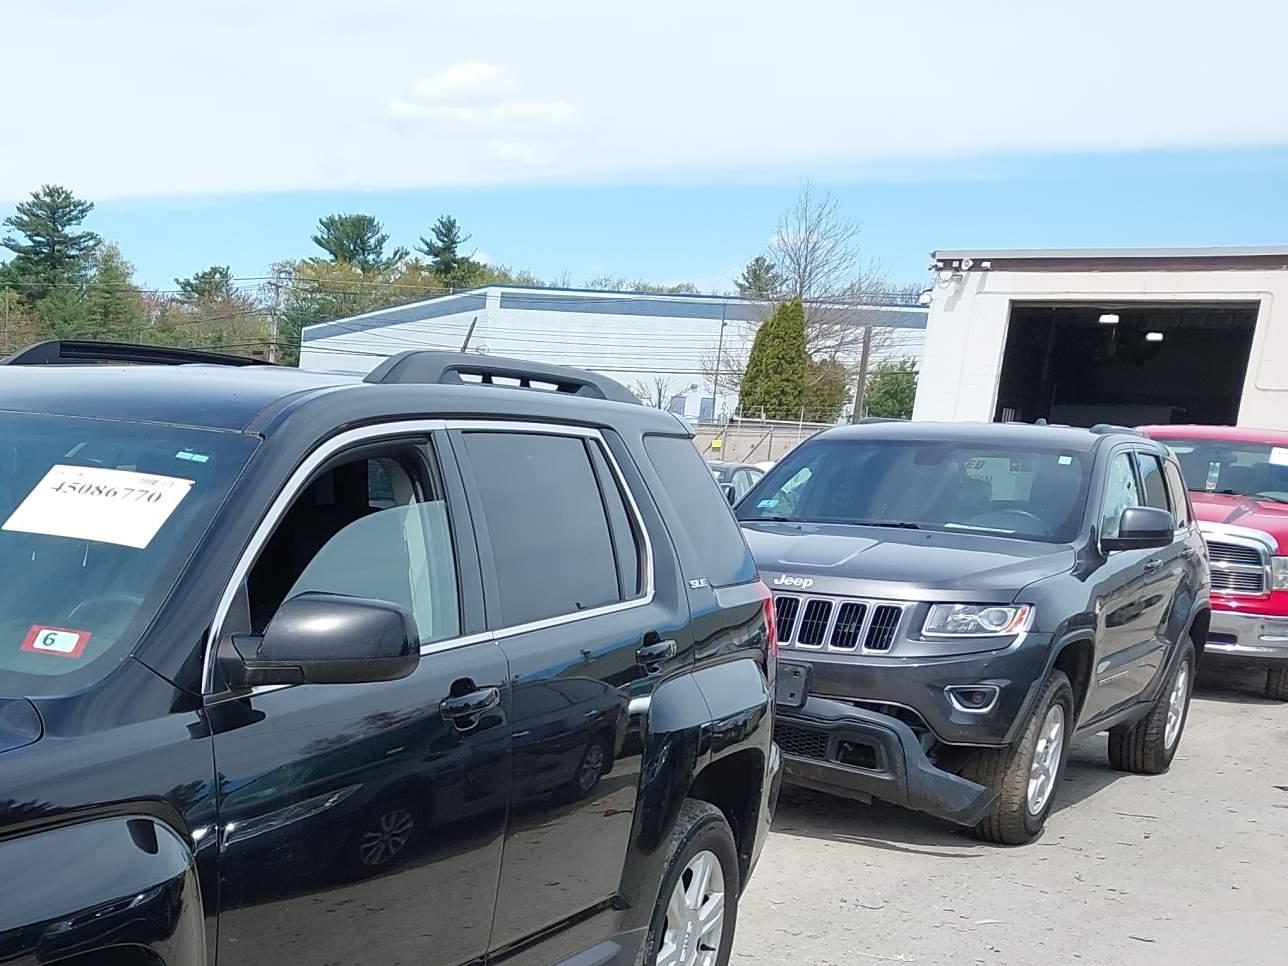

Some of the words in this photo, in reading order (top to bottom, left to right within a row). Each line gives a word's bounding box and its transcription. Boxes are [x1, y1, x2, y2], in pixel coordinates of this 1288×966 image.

[51, 481, 162, 503] 45086770
[689, 578, 708, 589] SLE
[774, 574, 814, 589] Jeep
[42, 632, 58, 647] 6
